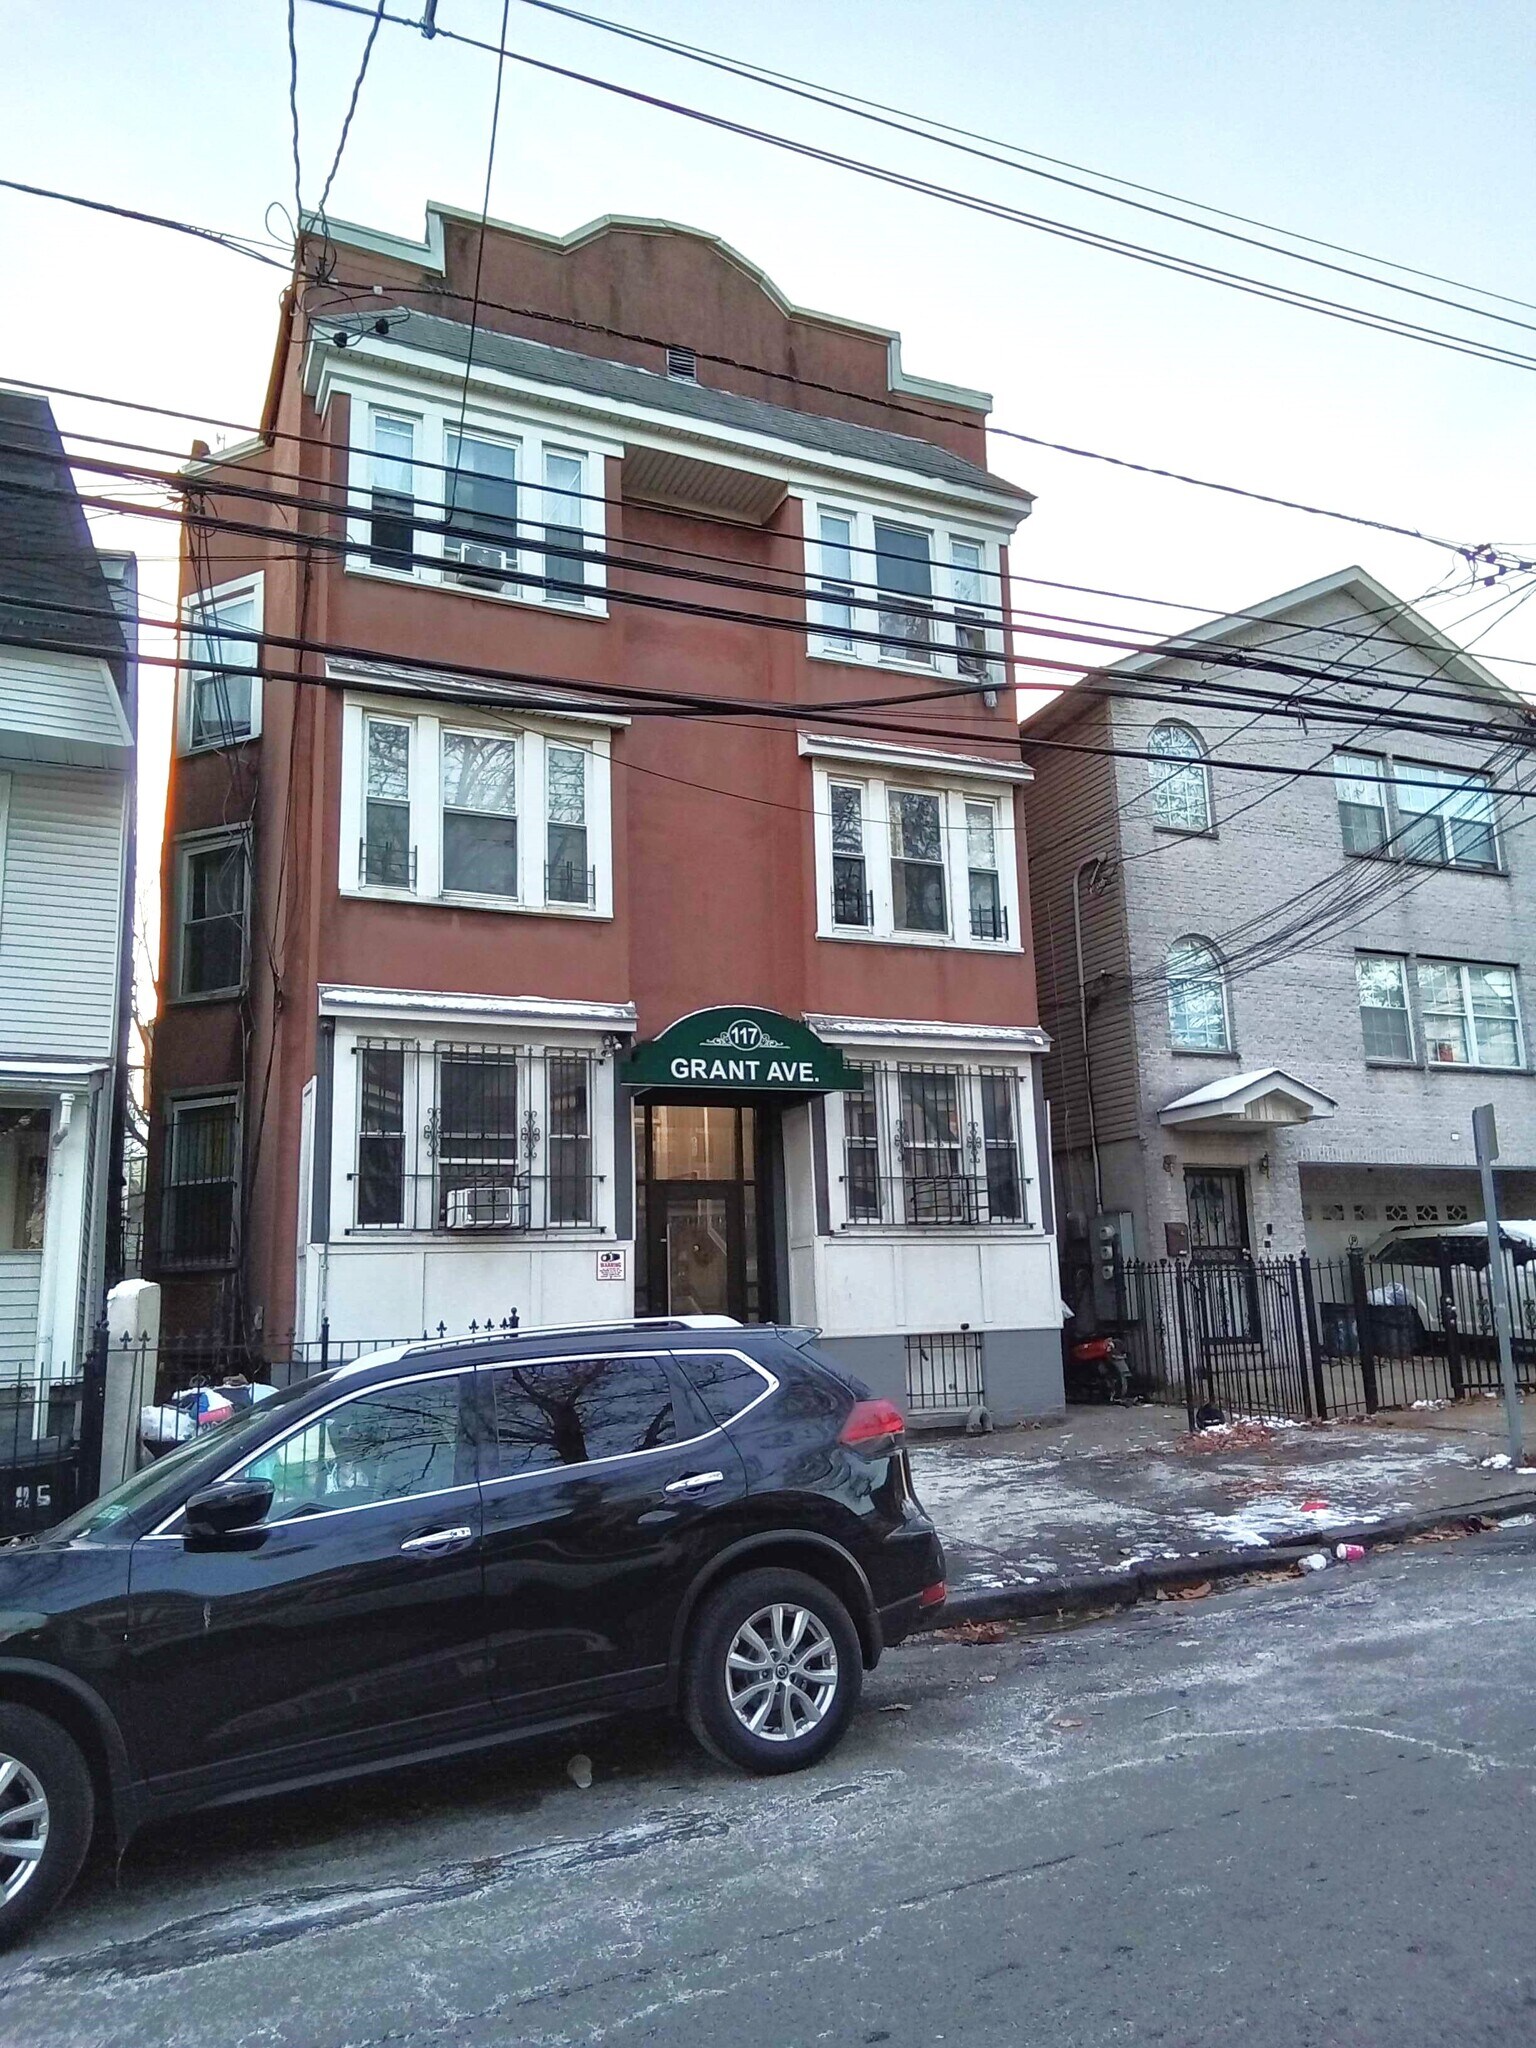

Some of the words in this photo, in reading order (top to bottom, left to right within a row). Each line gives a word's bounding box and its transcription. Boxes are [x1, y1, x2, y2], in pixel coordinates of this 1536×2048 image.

[731, 1026, 758, 1045] 117
[670, 1058, 760, 1080] GRANT
[766, 1061, 820, 1082] AVE.
